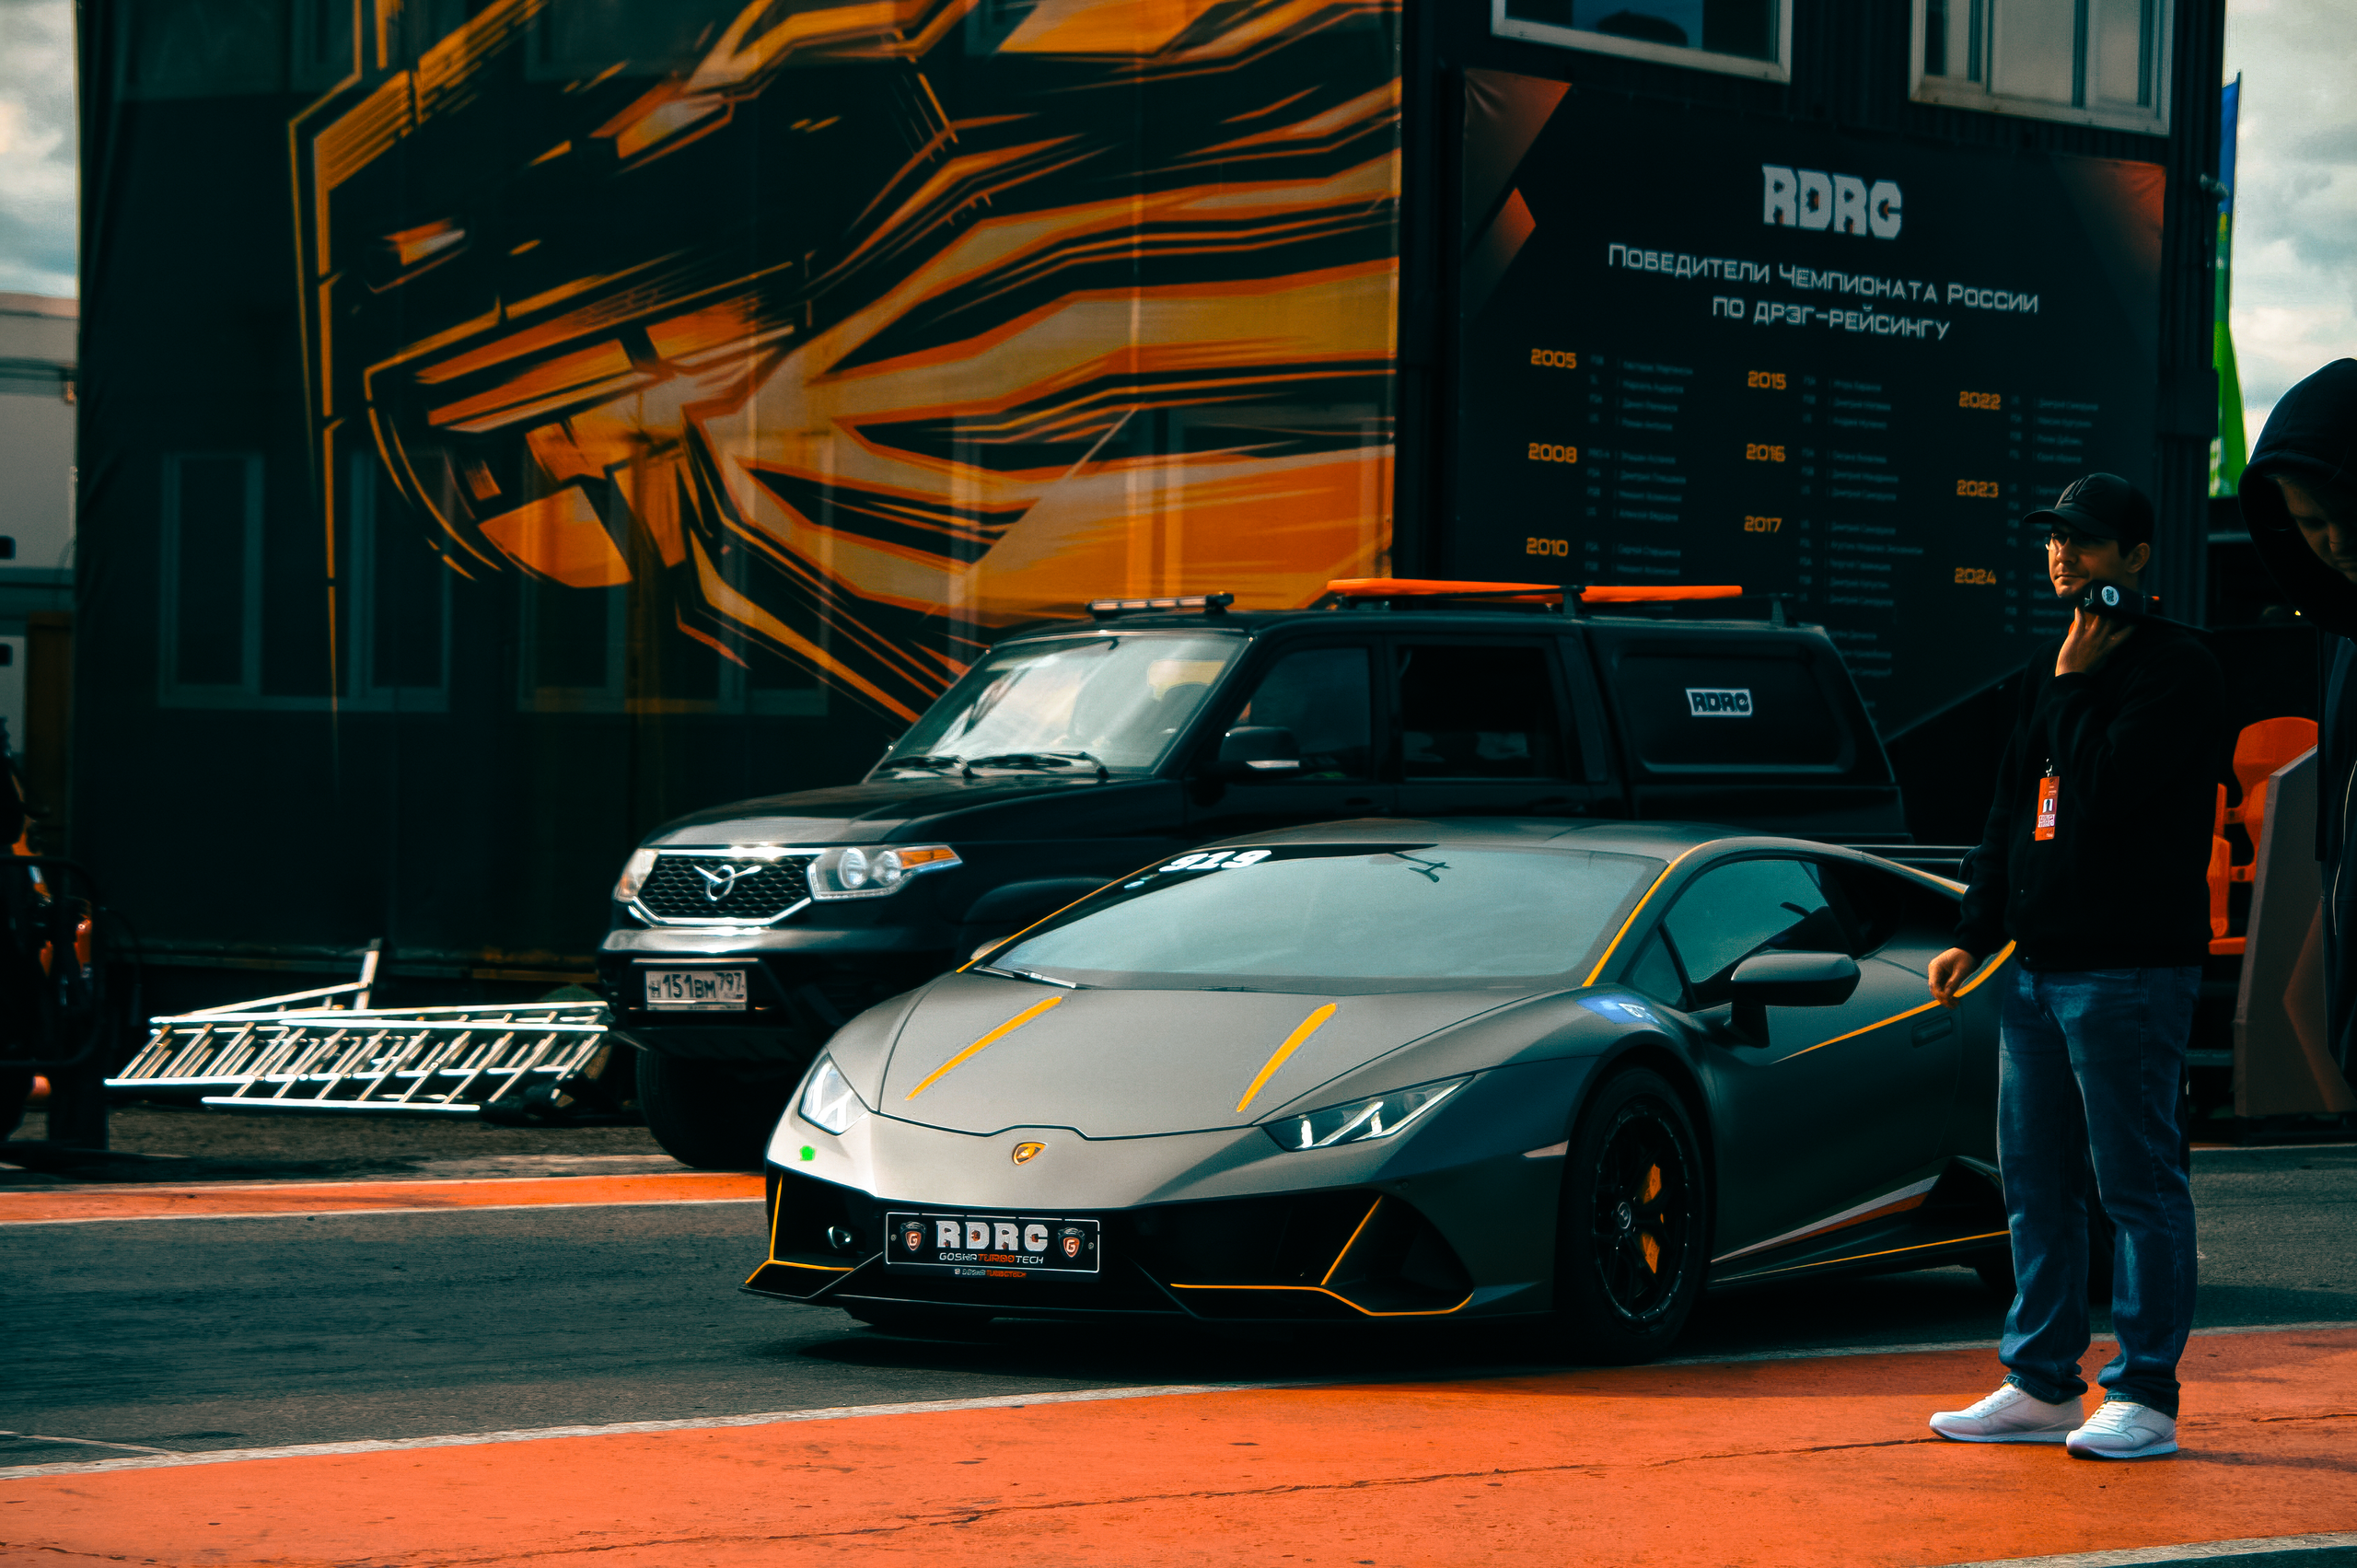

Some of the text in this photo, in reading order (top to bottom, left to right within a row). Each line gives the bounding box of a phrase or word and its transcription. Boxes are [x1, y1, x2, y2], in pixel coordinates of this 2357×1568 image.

[1761, 164, 1903, 240] RDRC
[1530, 347, 1578, 369] 2005
[1747, 370, 1788, 390] 2015
[1958, 390, 2001, 411] 2022
[1527, 442, 1579, 464] 2008
[1956, 478, 2000, 499] 2023
[1744, 515, 1783, 533] 2017
[1526, 537, 1570, 557] 2010
[1954, 566, 1998, 586] 2024
[1690, 691, 1749, 713] RDRC
[1158, 849, 1272, 873] 919
[935, 1221, 1049, 1252] RDRC
